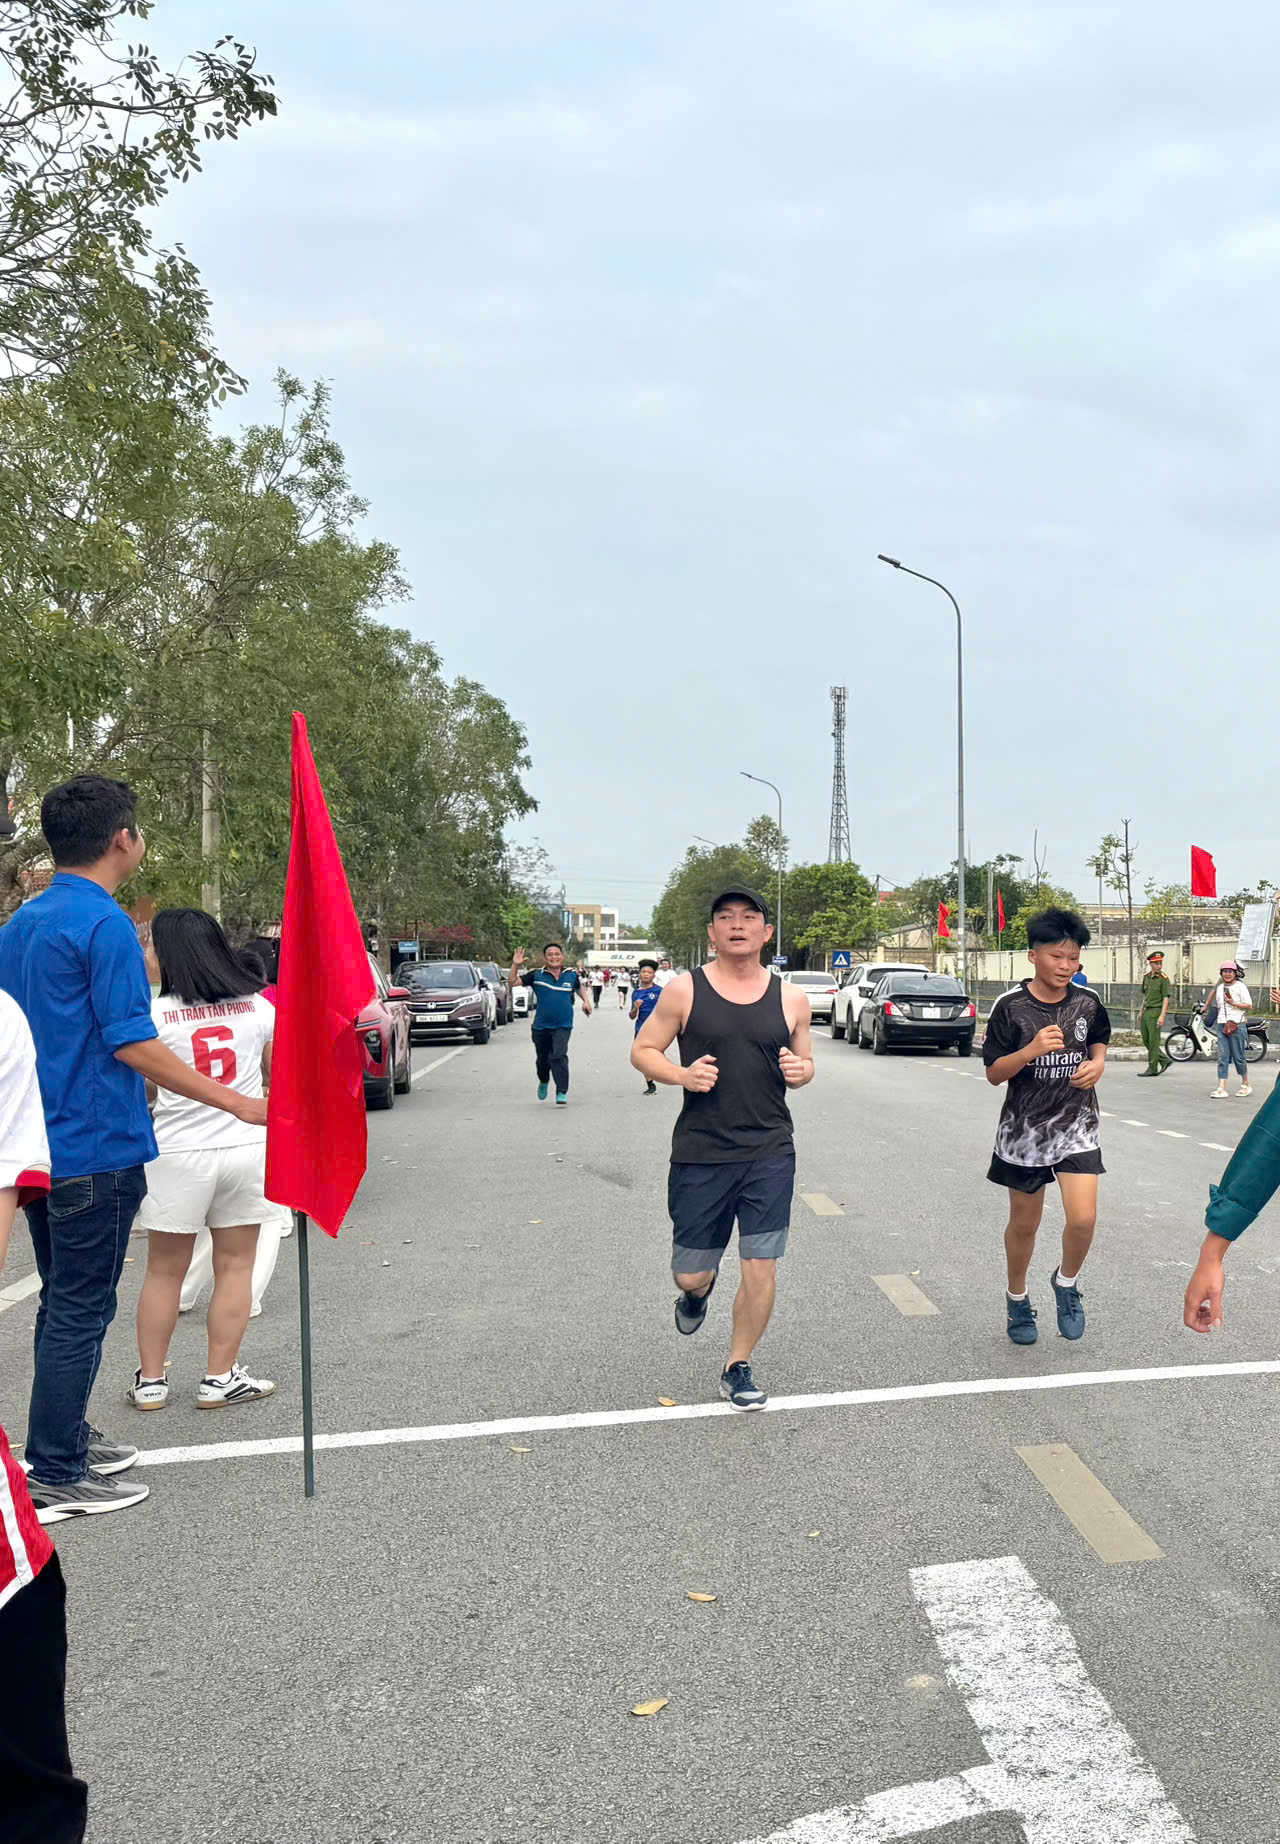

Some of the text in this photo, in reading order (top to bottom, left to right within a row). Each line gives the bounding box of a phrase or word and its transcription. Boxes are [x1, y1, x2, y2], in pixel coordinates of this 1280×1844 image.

[163, 1009, 180, 1025] THỊ
[191, 1025, 237, 1085] 6
[1034, 1067, 1049, 1079] FLY
